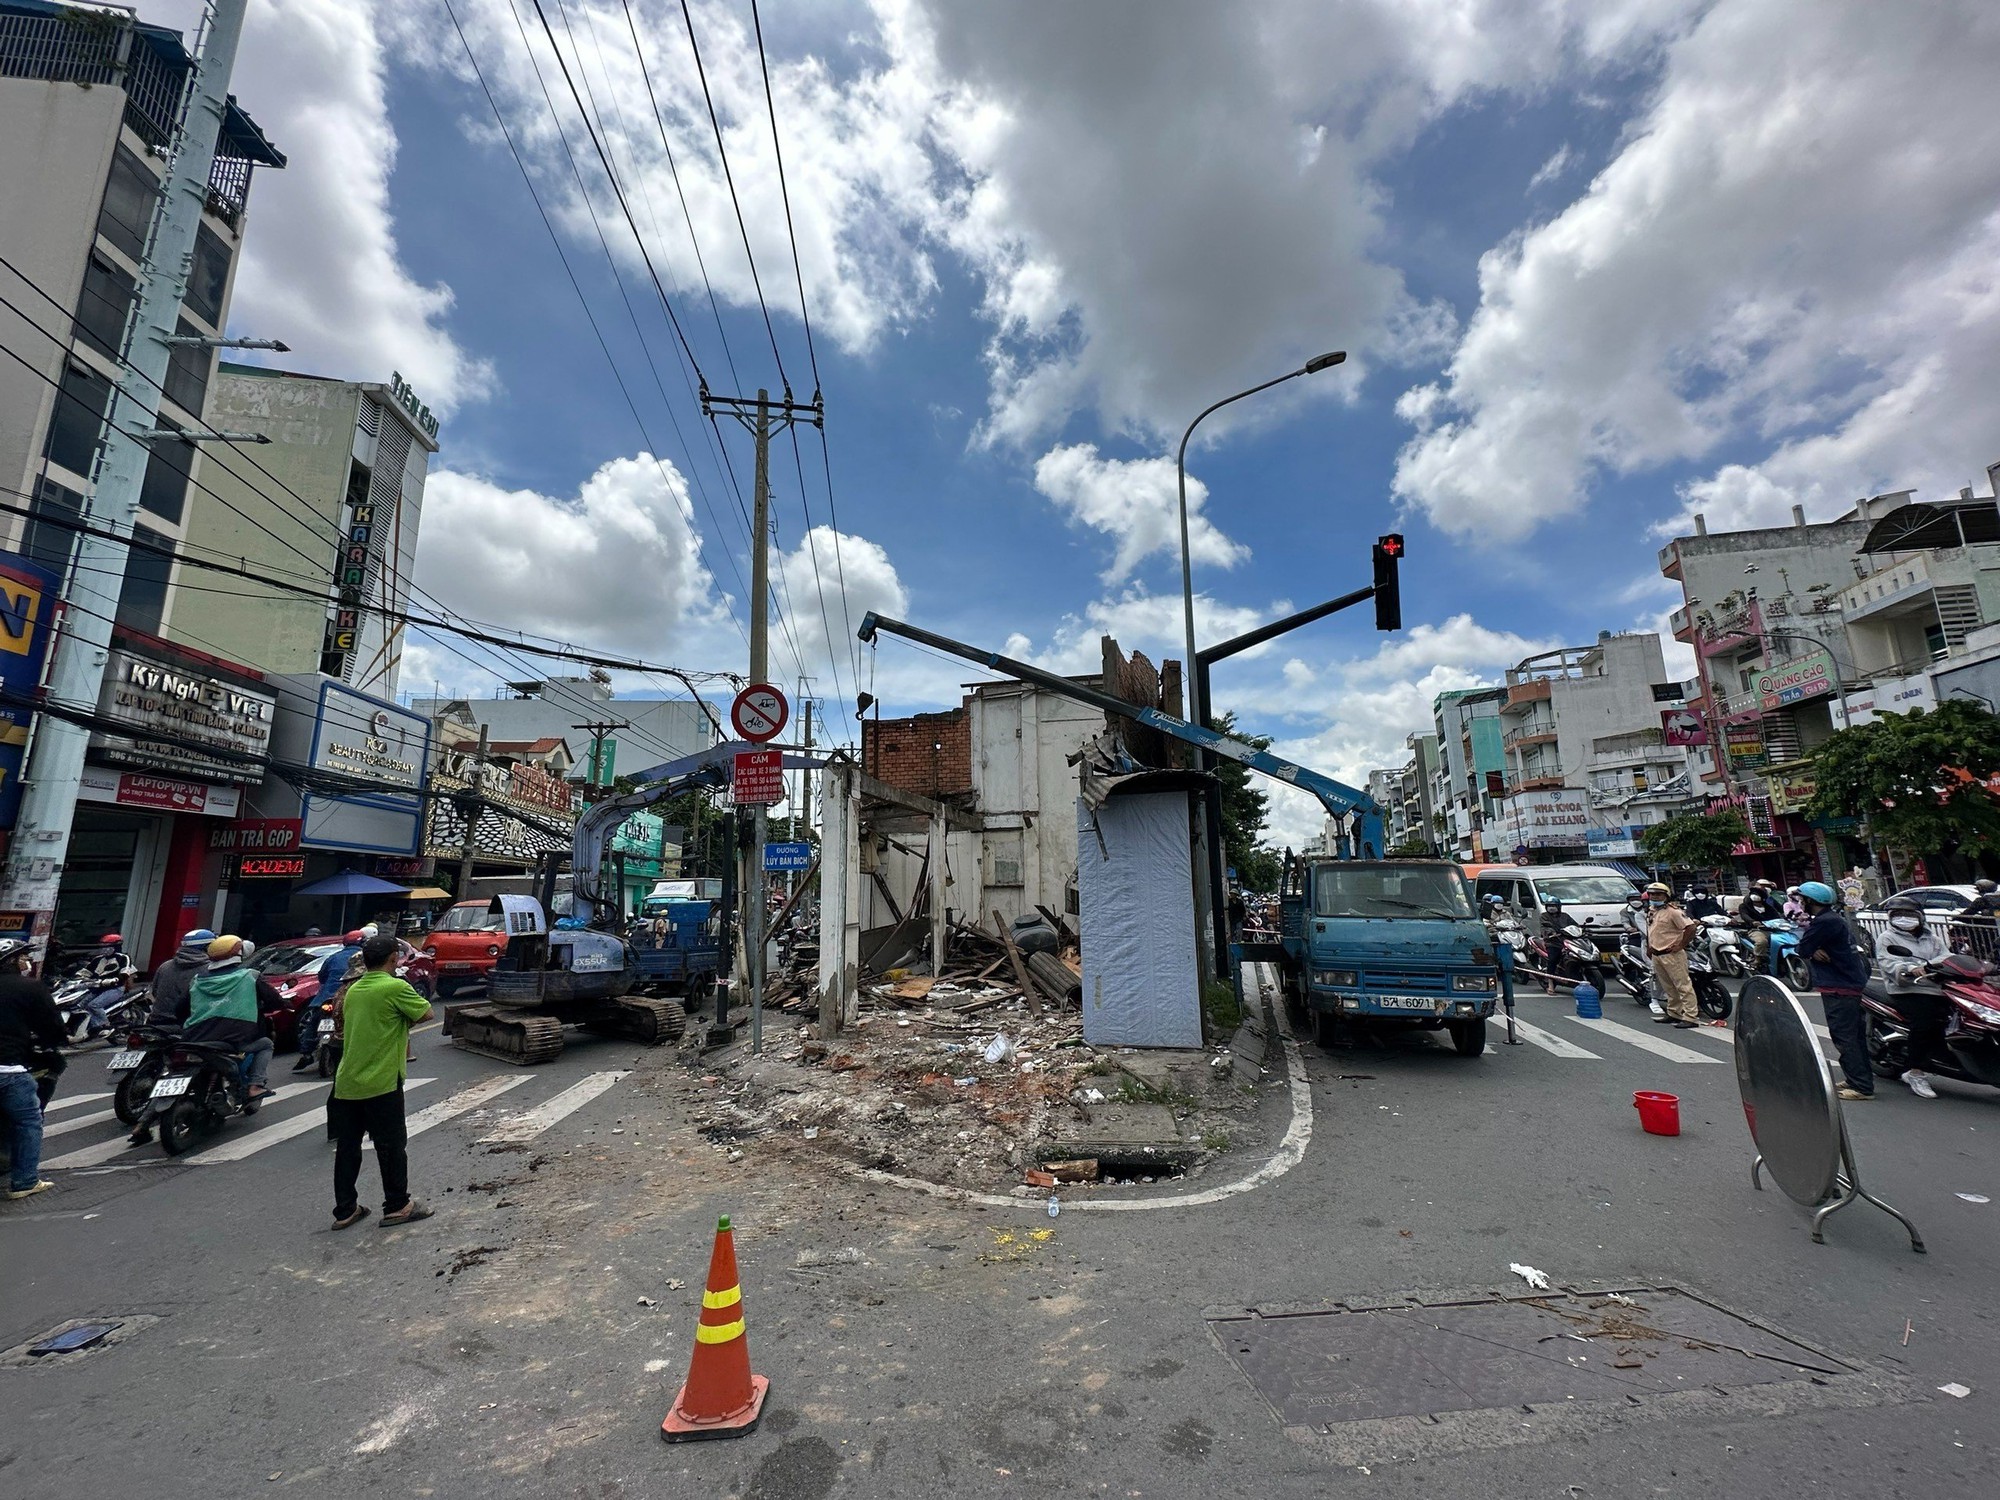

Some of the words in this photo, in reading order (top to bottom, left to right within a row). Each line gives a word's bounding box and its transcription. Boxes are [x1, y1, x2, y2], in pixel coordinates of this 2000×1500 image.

[130, 664, 160, 690] Kỹ
[230, 694, 266, 722] Việt
[234, 722, 268, 741] CAMERA
[109, 750, 126, 760] 906
[130, 776, 202, 796] LAPTOPVIP.VN
[1551, 814, 1587, 826] KHANG
